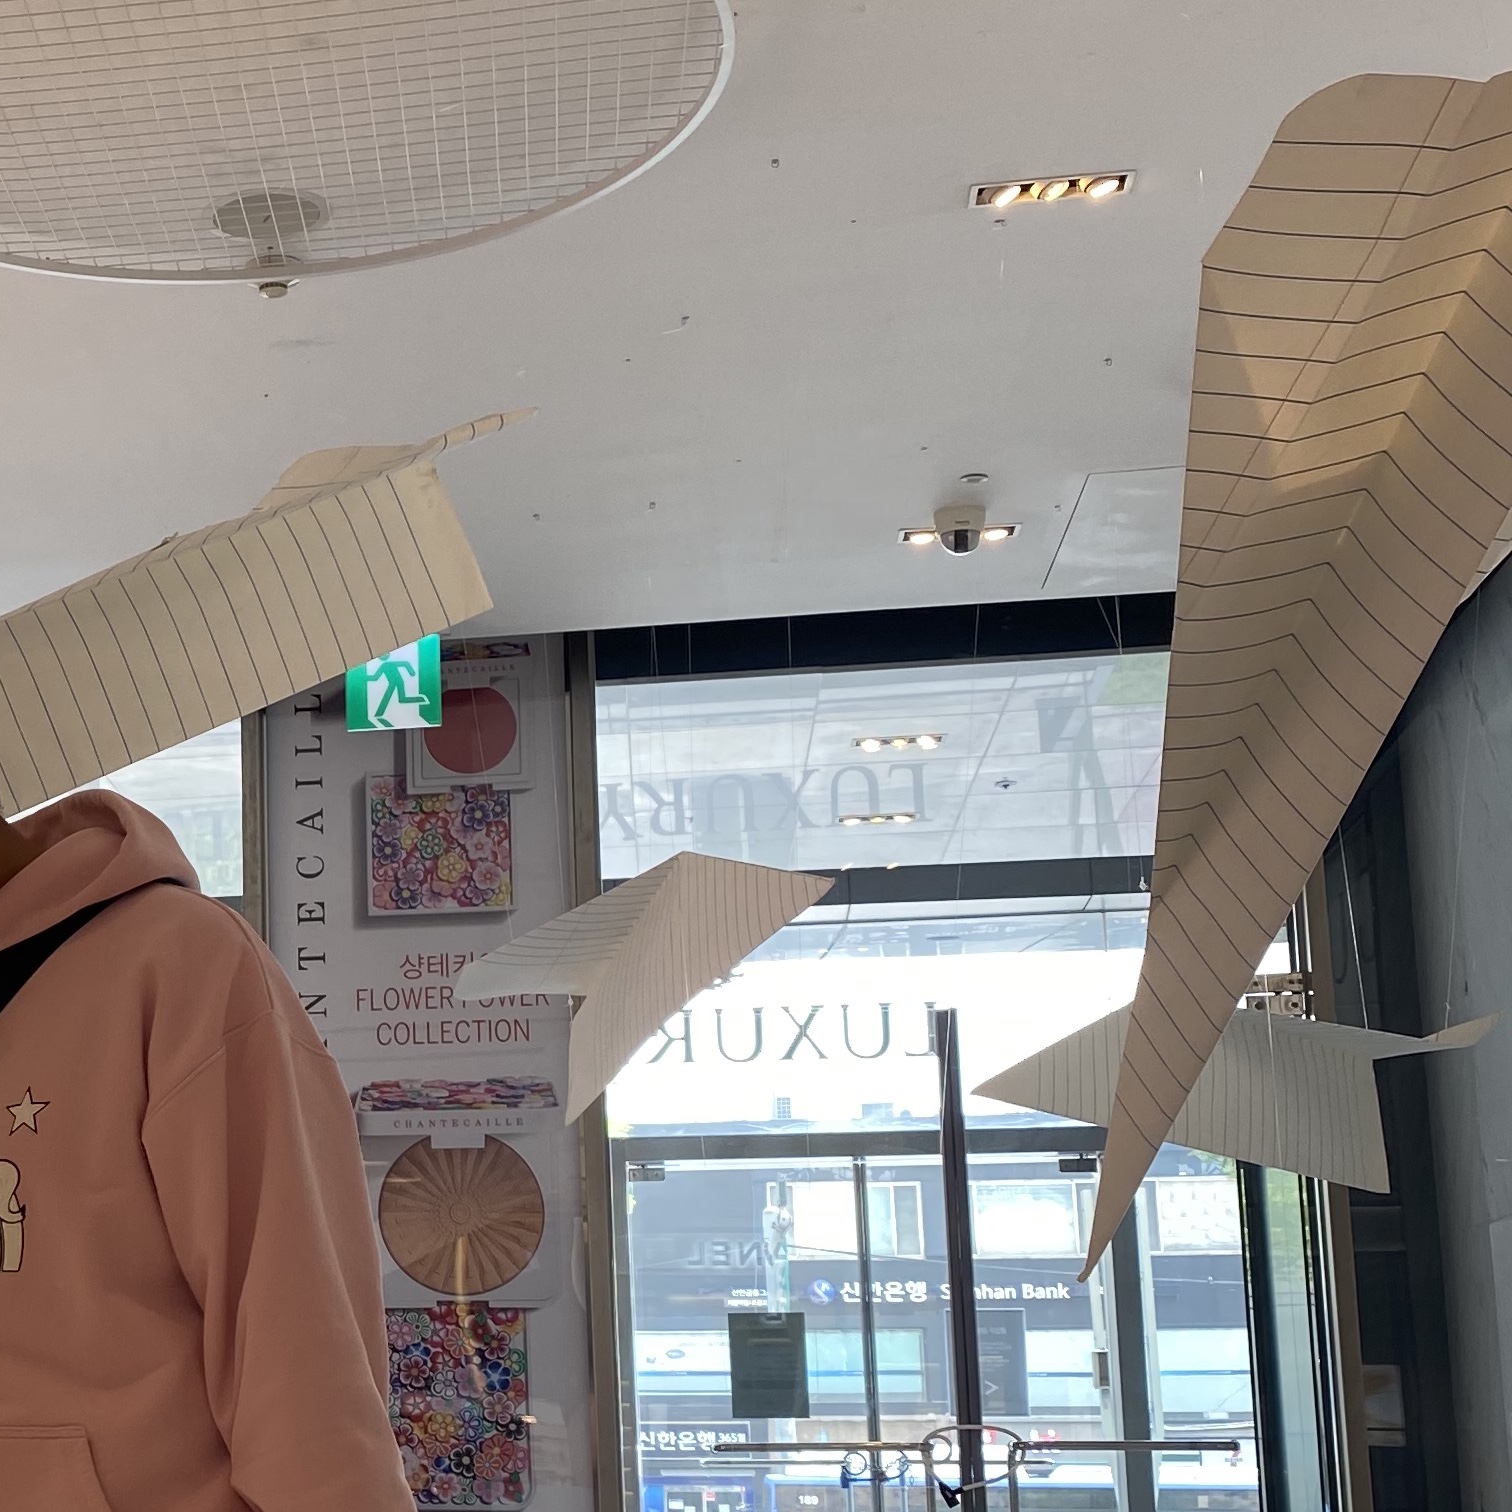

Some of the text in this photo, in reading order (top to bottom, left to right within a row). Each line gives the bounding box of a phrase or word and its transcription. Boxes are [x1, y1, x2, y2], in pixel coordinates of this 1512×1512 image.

[293, 692, 329, 1049] NTECAILL
[355, 986, 454, 1013] FLOWER
[376, 1018, 531, 1046] COLLECTION
[393, 1117, 525, 1129] CHANTECAILLE
[939, 1283, 1018, 1301] Snhan
[1021, 1283, 1071, 1301] Bank
